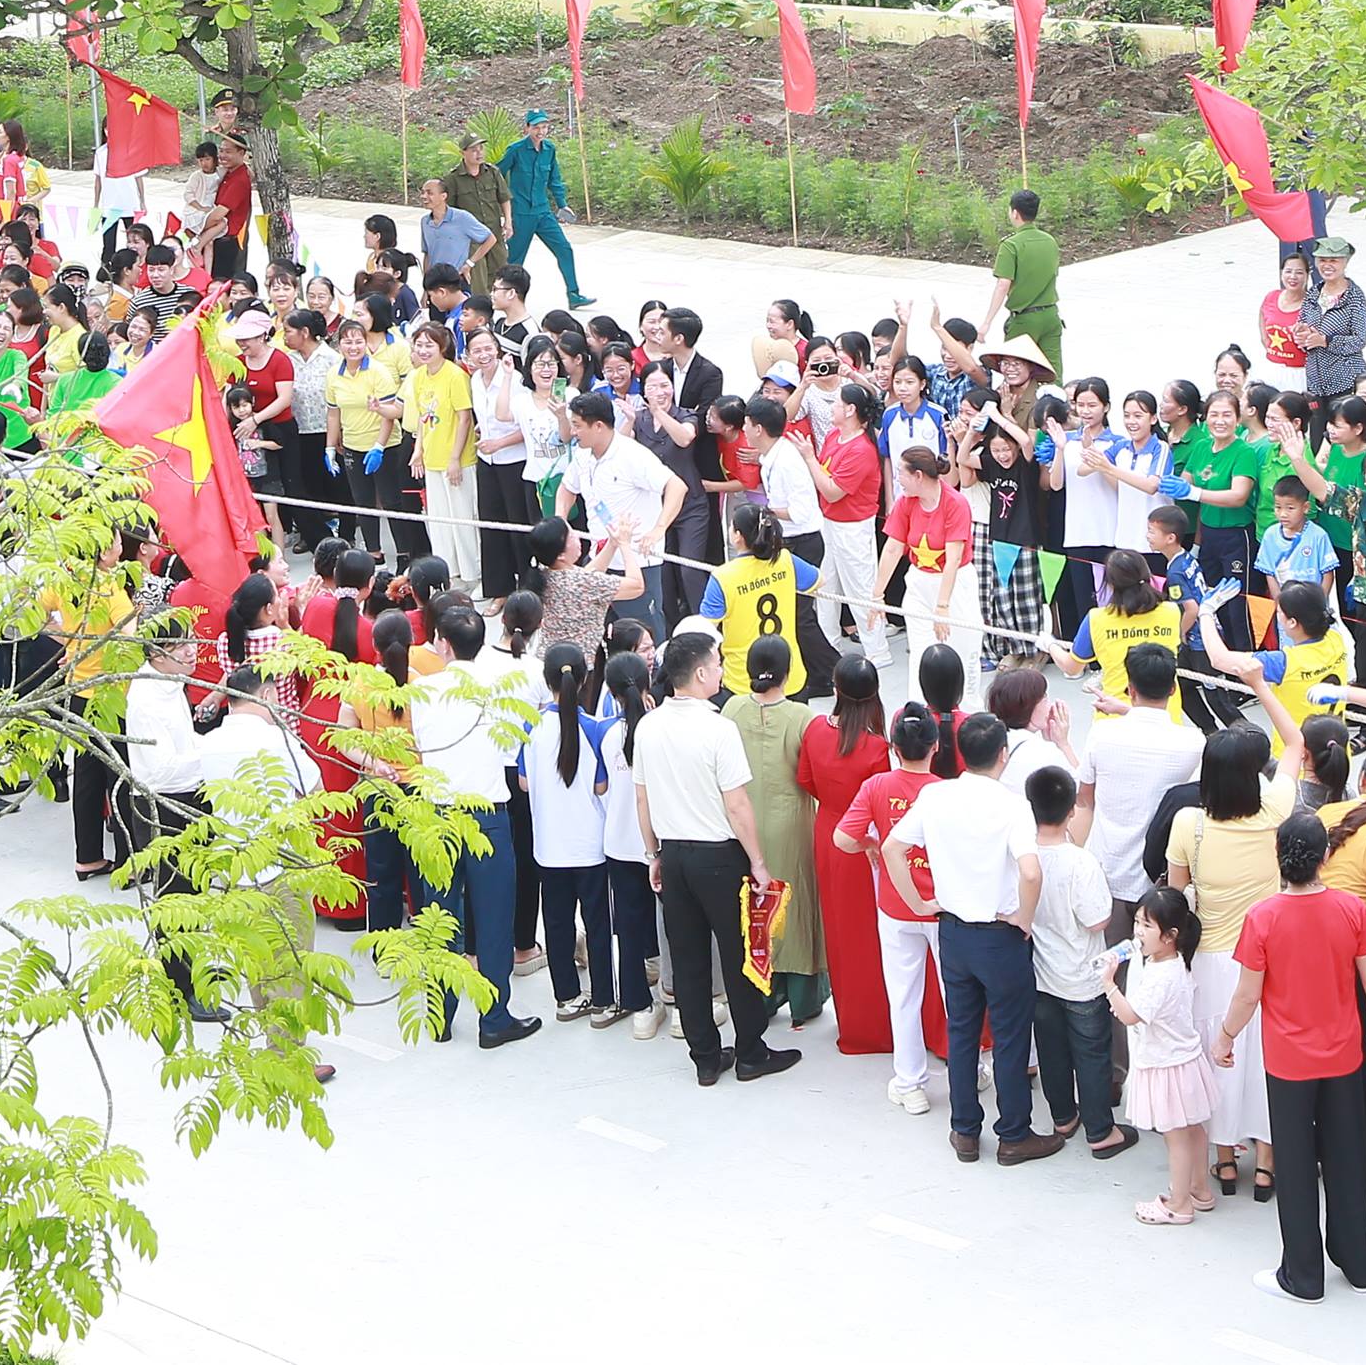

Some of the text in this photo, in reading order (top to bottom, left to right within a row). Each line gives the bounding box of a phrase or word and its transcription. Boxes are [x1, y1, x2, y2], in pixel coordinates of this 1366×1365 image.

[737, 584, 749, 596] TH
[749, 577, 770, 592] Đồng
[756, 593, 783, 637] 8
[1106, 625, 1172, 640] TH Đồng Sơn
